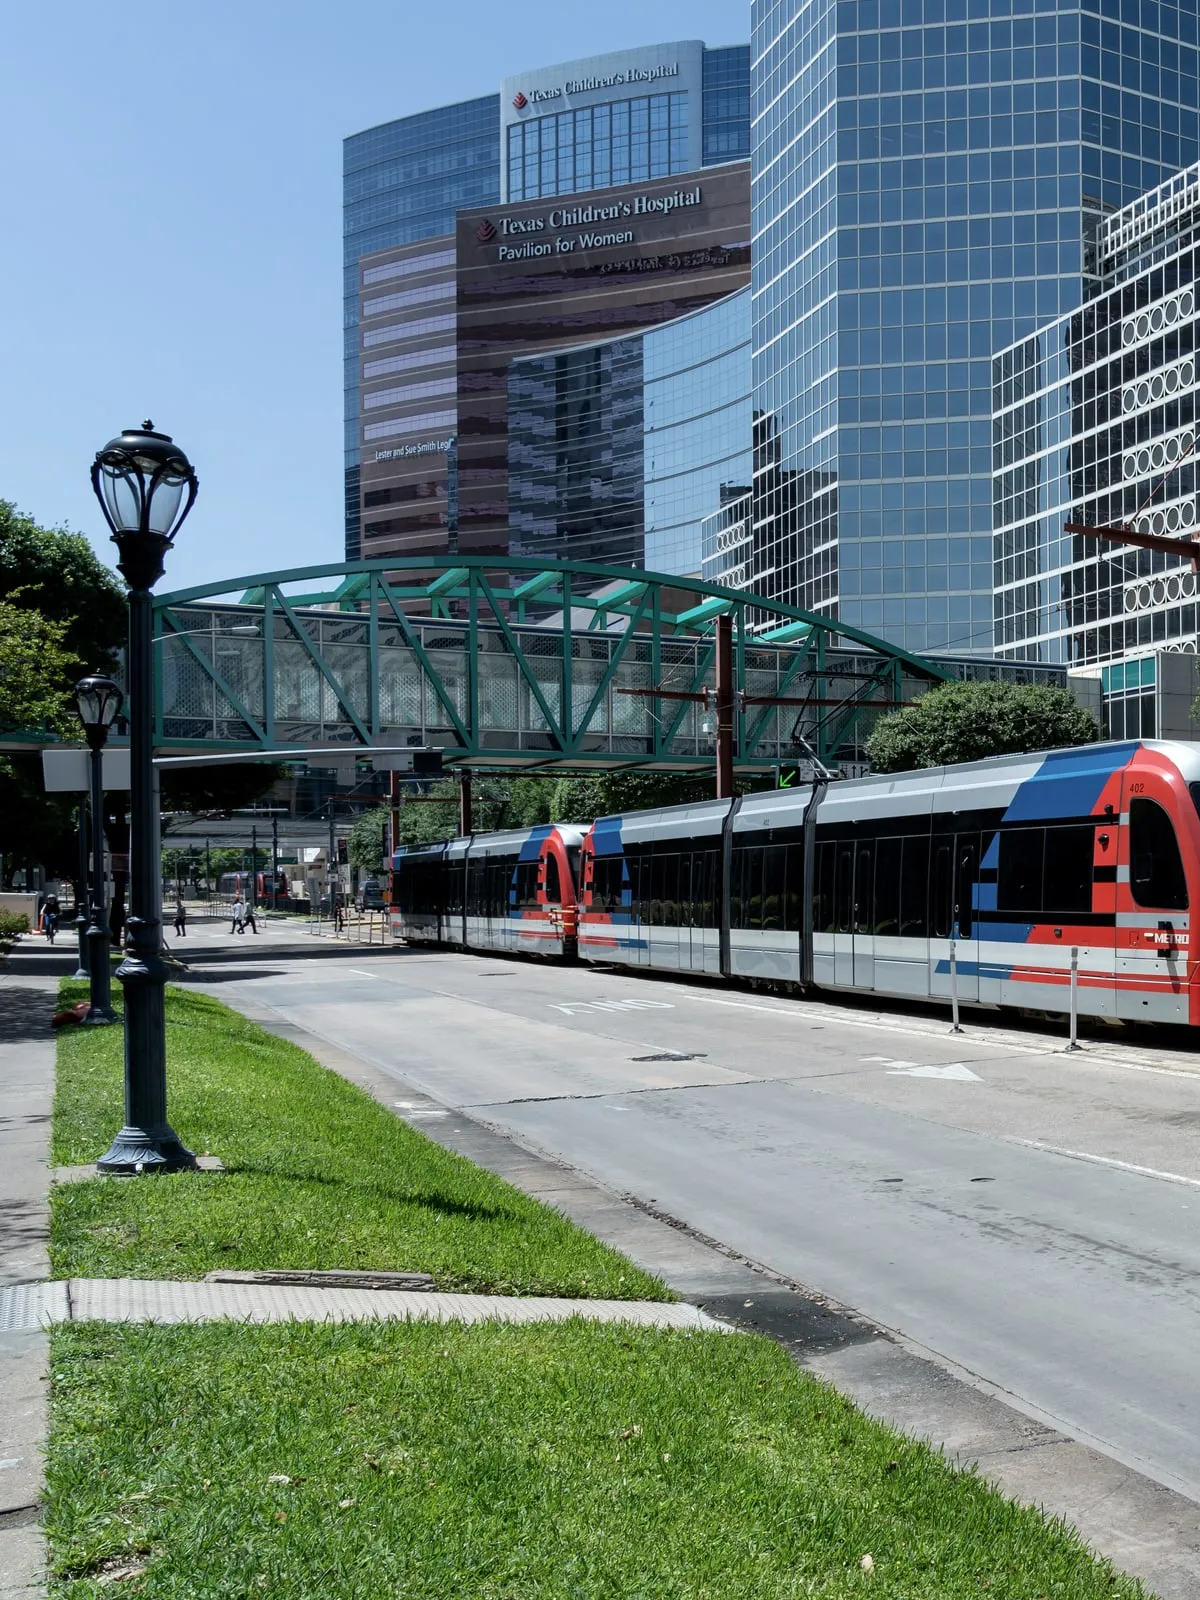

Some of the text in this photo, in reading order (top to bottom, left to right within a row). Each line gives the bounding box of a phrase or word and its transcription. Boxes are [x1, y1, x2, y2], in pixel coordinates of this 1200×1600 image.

[529, 62, 679, 104] Texas Children's Hospital
[499, 187, 701, 236] Texas Children's Hospital
[499, 230, 633, 261] Pavilion for Women
[375, 450, 393, 460] Lester
[393, 445, 404, 457] and
[405, 445, 417, 455] Sue
[417, 441, 436, 453] Smith
[1129, 782, 1145, 793] 402
[1154, 932, 1190, 945] METRO
